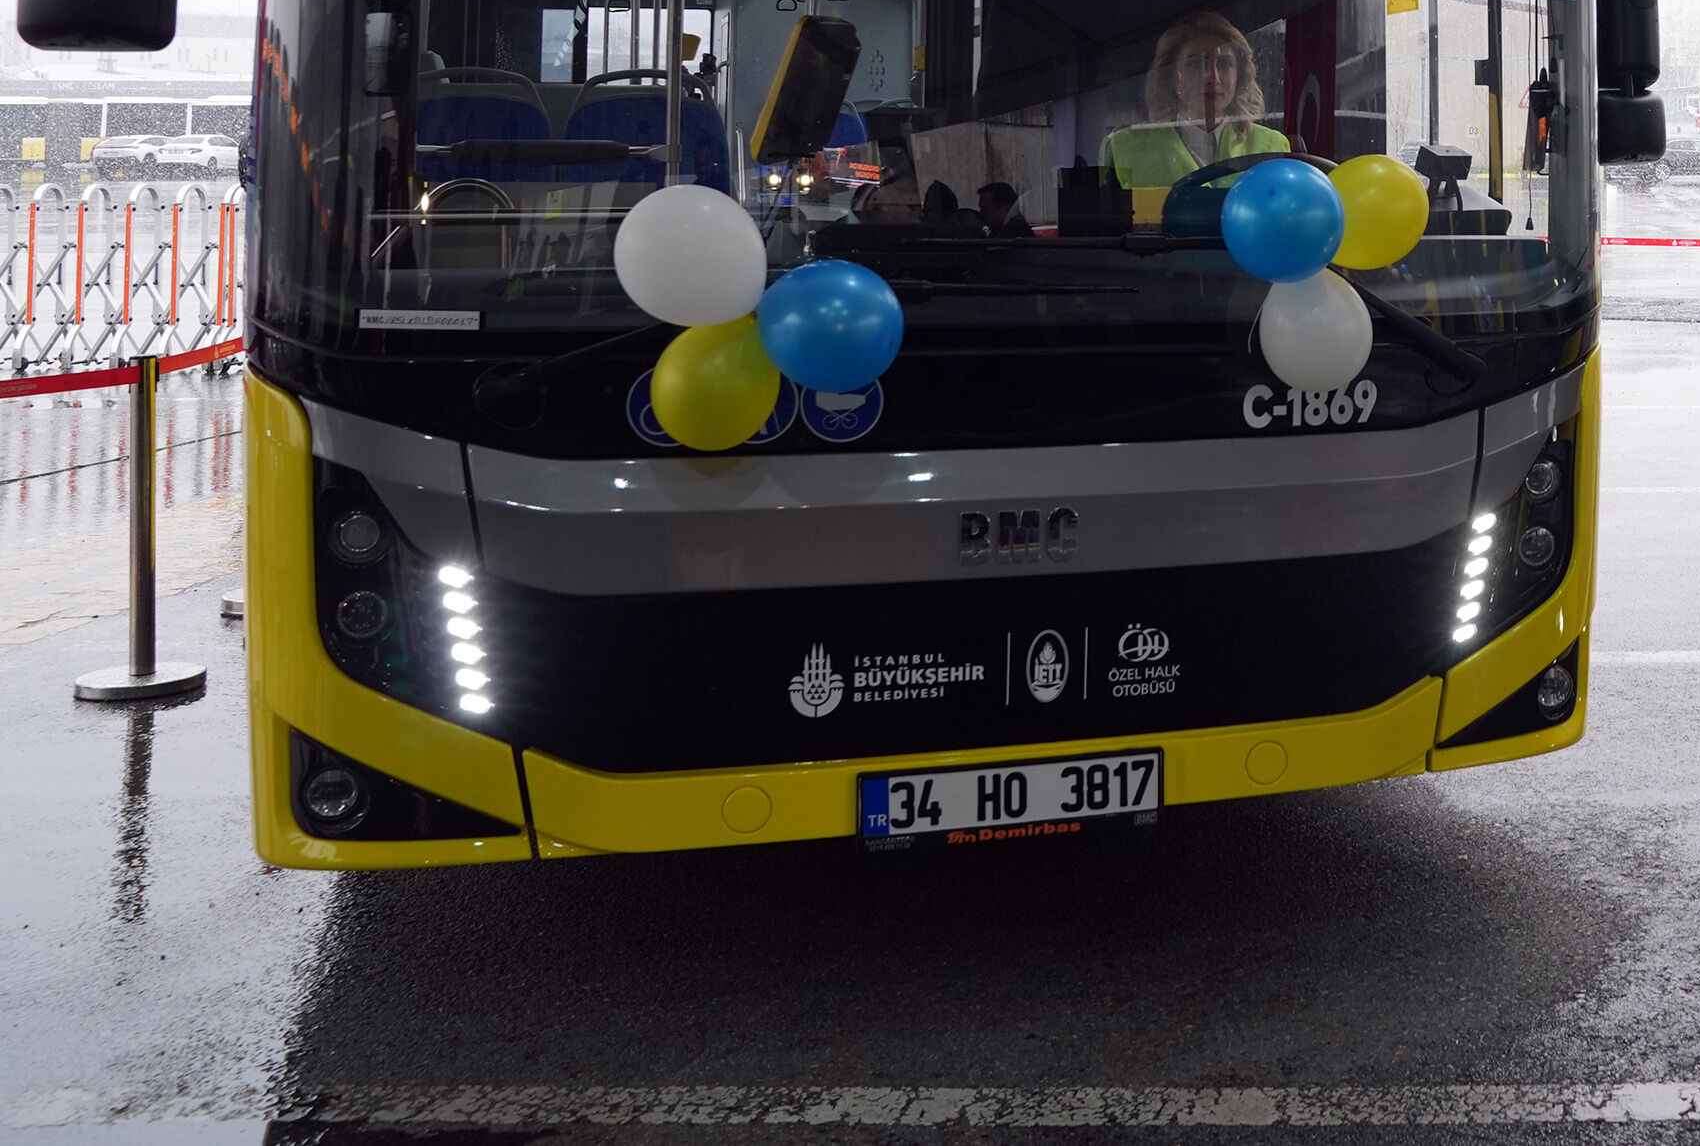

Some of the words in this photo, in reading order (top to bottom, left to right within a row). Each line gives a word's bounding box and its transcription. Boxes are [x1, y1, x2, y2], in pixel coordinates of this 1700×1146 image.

[1243, 379, 1378, 429] C-1869
[960, 505, 1079, 567] BMC
[854, 653, 945, 667] İSTANBUL
[853, 663, 985, 687] BÜYÜKŞEHİR
[1108, 667, 1142, 682] ÖZEL
[1145, 664, 1181, 679] HALK
[853, 686, 945, 703] BELEDİYESİ
[1112, 679, 1176, 698] OTOBÜSÜ
[868, 814, 887, 828] TR
[890, 779, 942, 830] 34
[977, 771, 1027, 822] HO
[1061, 760, 1155, 813] 3817
